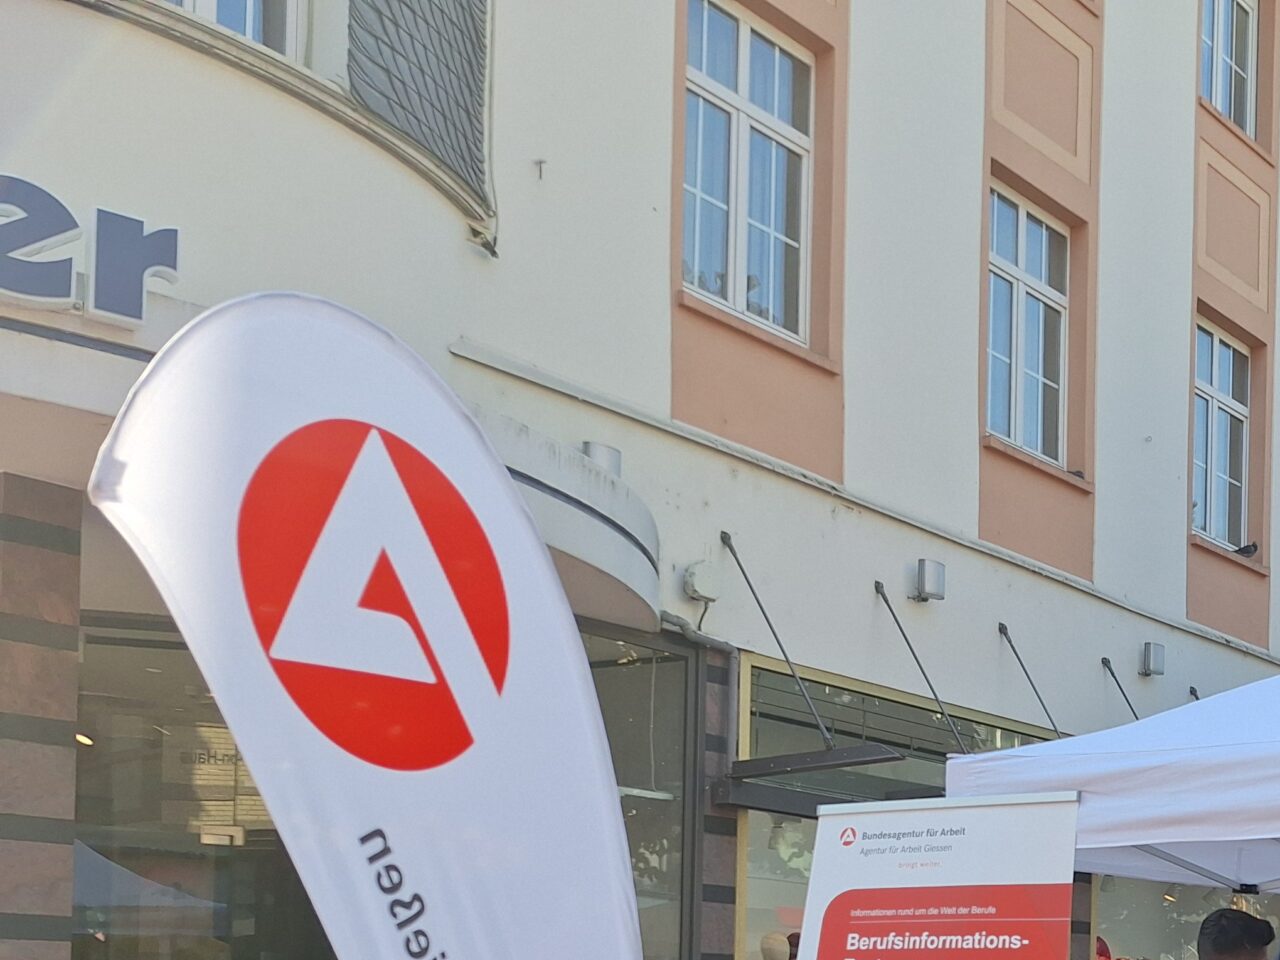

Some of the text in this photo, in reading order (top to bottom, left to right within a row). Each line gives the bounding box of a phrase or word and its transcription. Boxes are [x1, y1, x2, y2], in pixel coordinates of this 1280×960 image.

[861, 826, 966, 841] Bundesagentur für Arbeit
[860, 847, 887, 857] Agentur
[889, 845, 899, 854] für
[900, 844, 922, 853] Arbeit
[850, 905, 997, 917] Informationen rund um die Welt der Berufe
[846, 931, 1030, 951] Berufsinformations-
